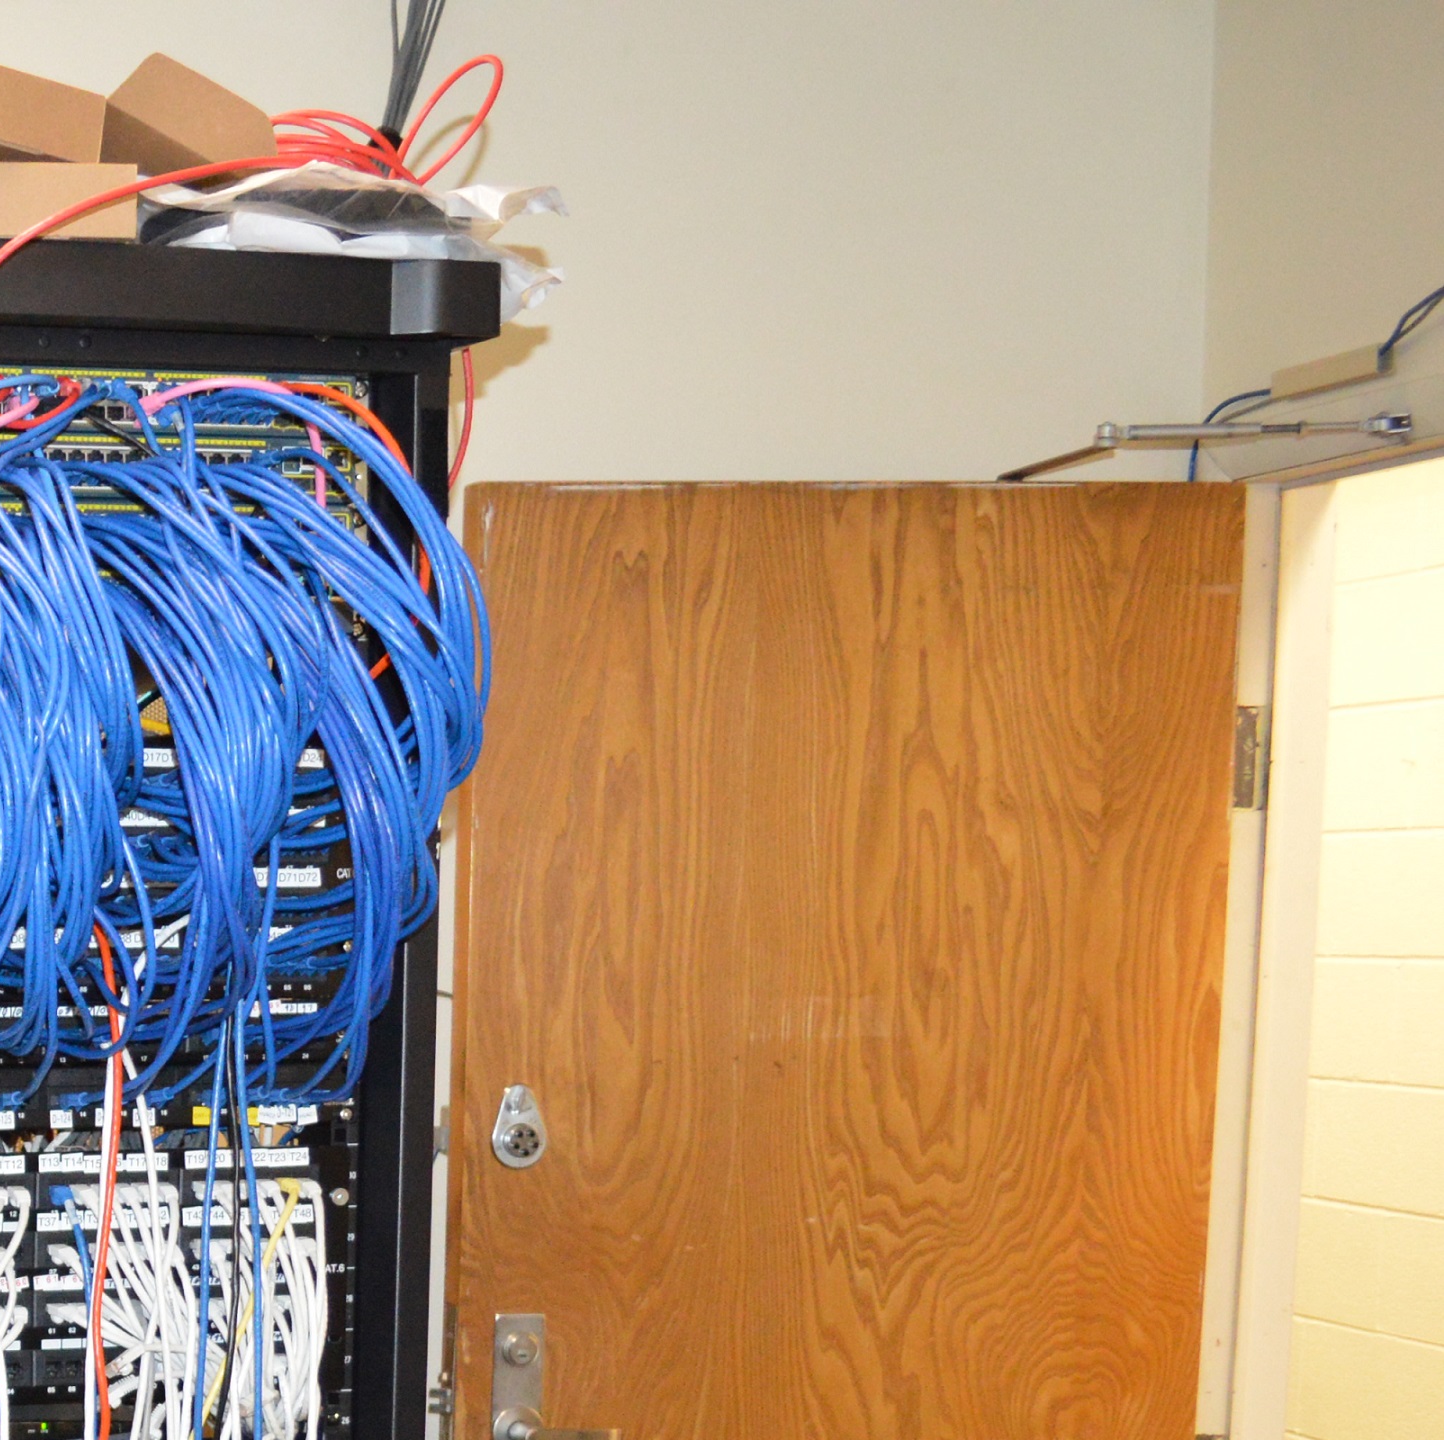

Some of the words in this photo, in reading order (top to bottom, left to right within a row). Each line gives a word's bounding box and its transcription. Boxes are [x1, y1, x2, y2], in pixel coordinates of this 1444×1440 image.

[303, 752, 323, 762] D24
[279, 873, 297, 882] D71
[298, 873, 318, 882] D72
[4, 1160, 22, 1169] T12
[41, 1157, 59, 1167] T13
[64, 1157, 83, 1167] T14
[83, 1158, 101, 1168] T15
[128, 1157, 146, 1167] T17
[186, 1154, 205, 1164] T19
[267, 1153, 286, 1163] T23
[288, 1151, 307, 1161] T24
[38, 1216, 57, 1227] T37
[293, 1208, 312, 1218] T48
